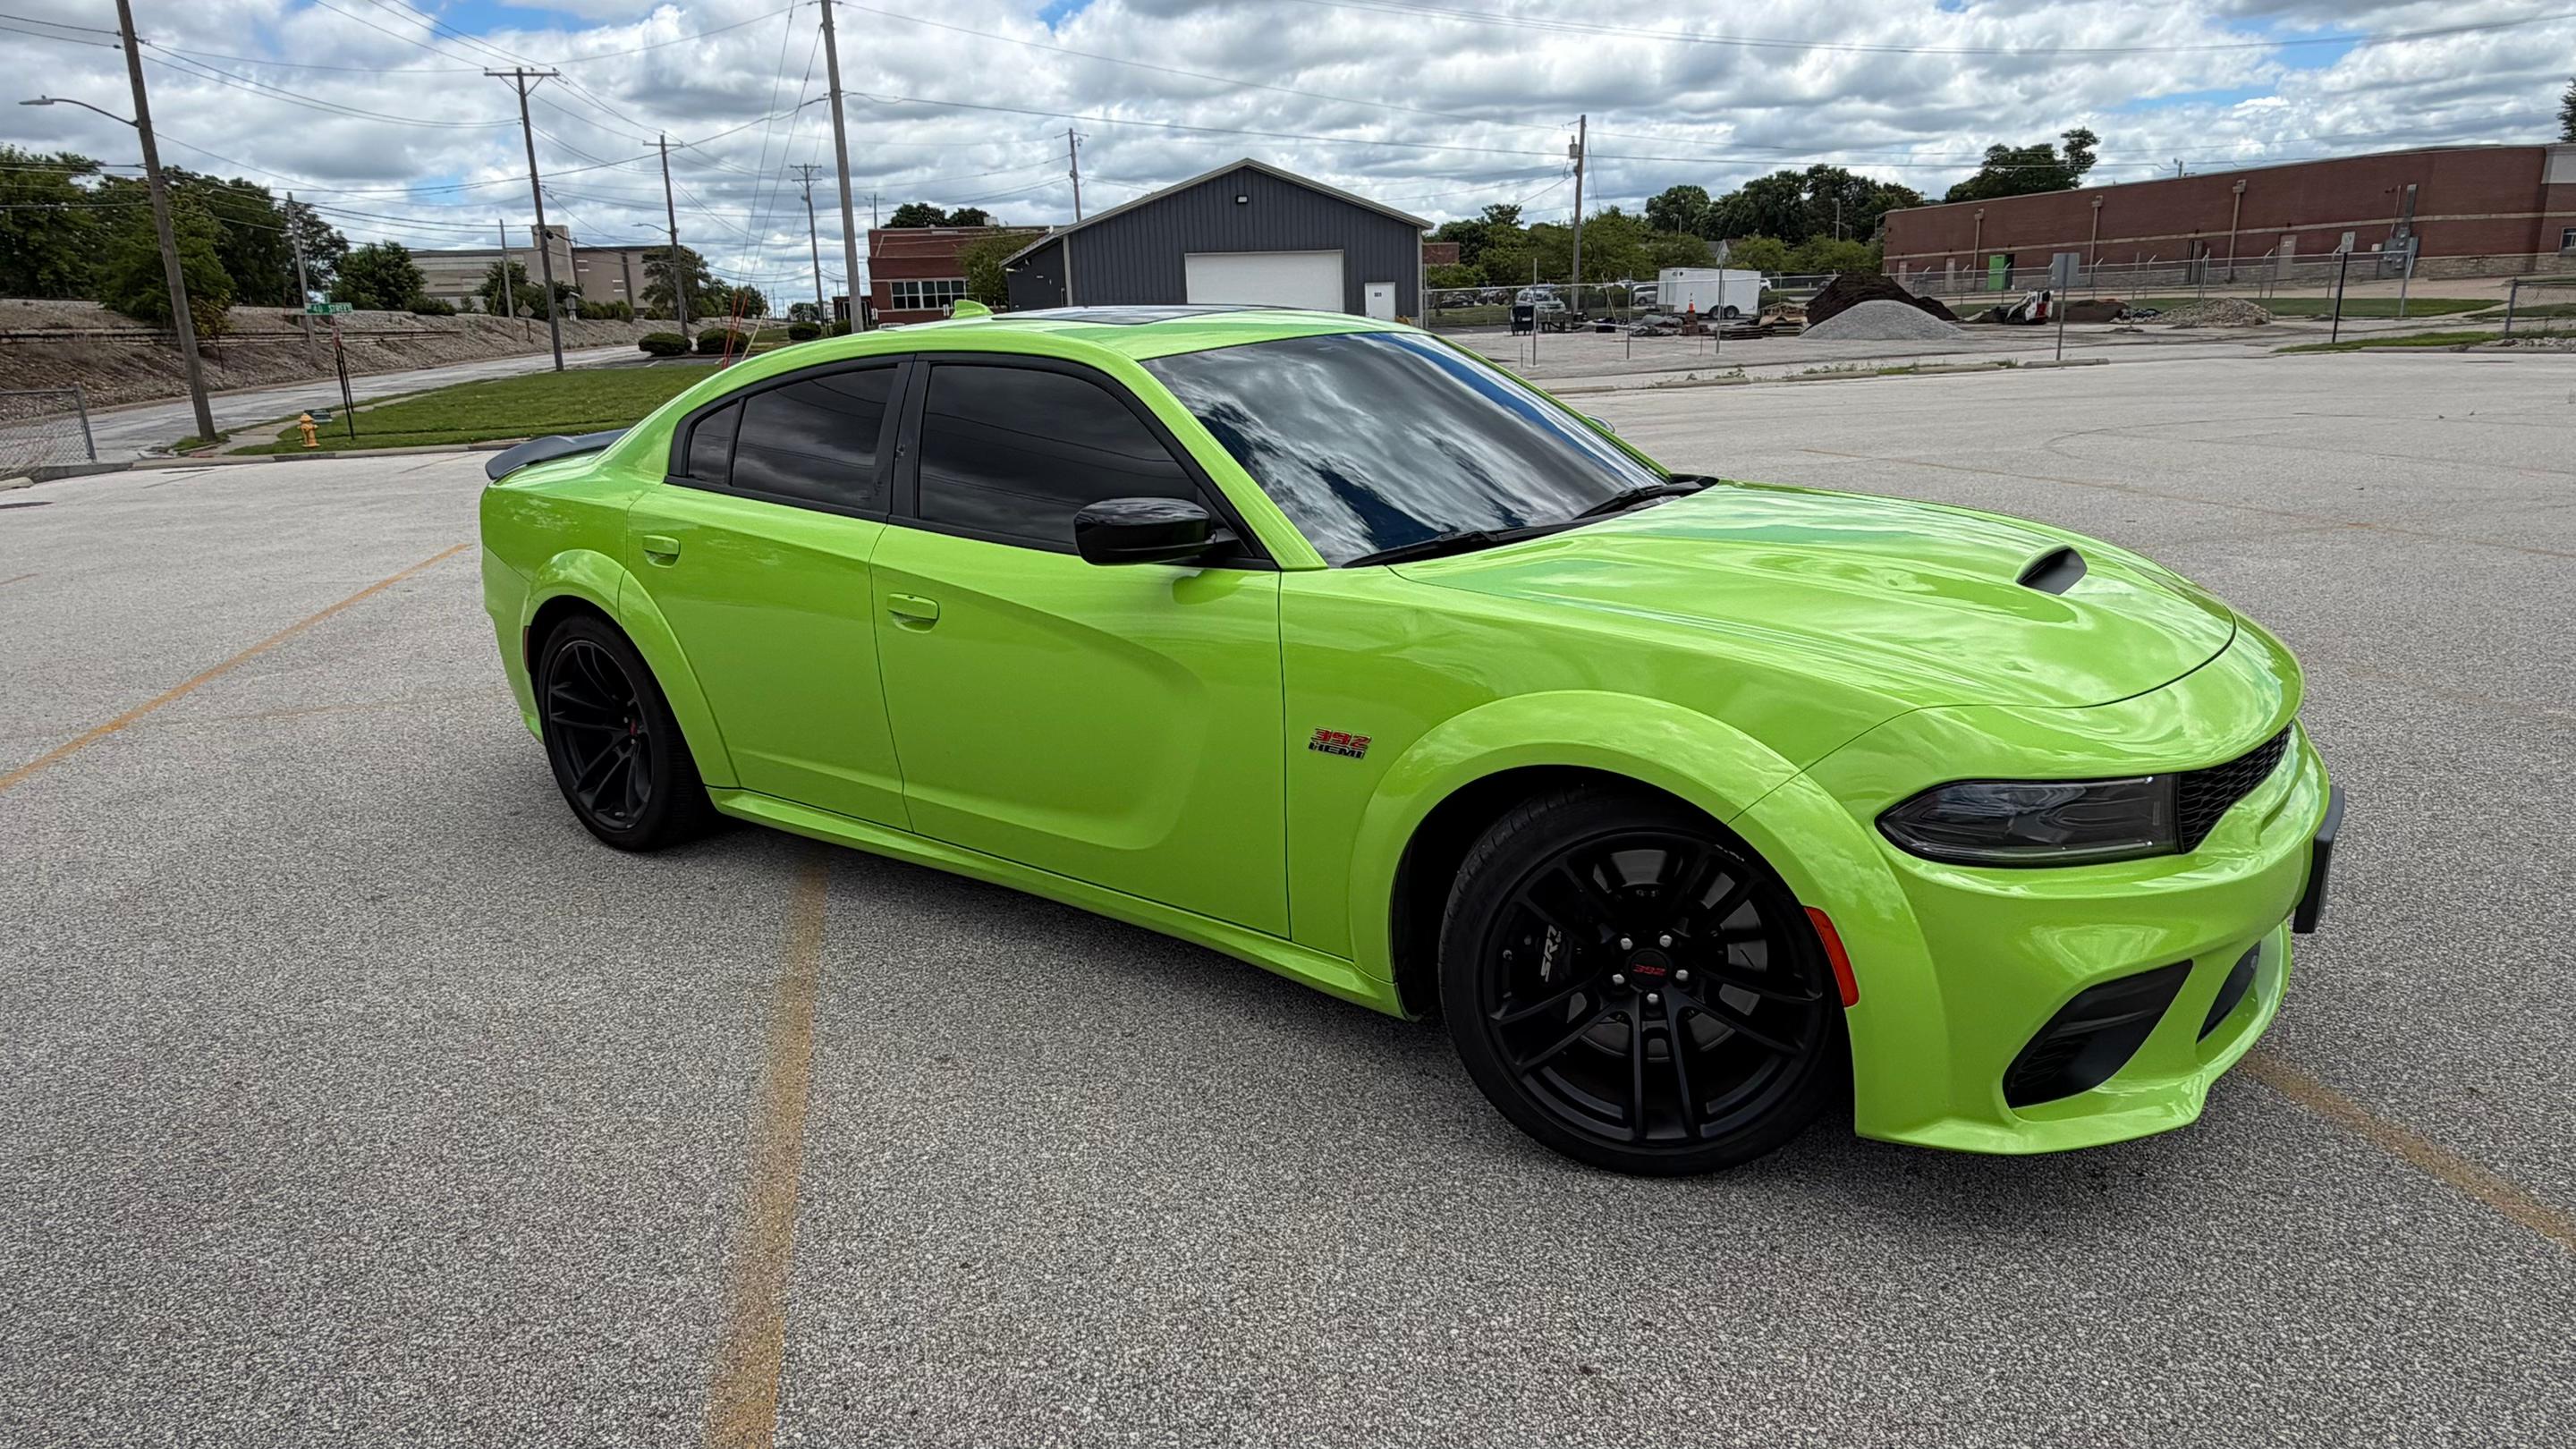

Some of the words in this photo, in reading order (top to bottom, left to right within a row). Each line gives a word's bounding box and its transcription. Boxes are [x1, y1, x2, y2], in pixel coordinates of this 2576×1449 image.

[1310, 727, 1372, 751] 392
[1309, 741, 1365, 759] HEMI
[1632, 963, 1666, 977] 392
